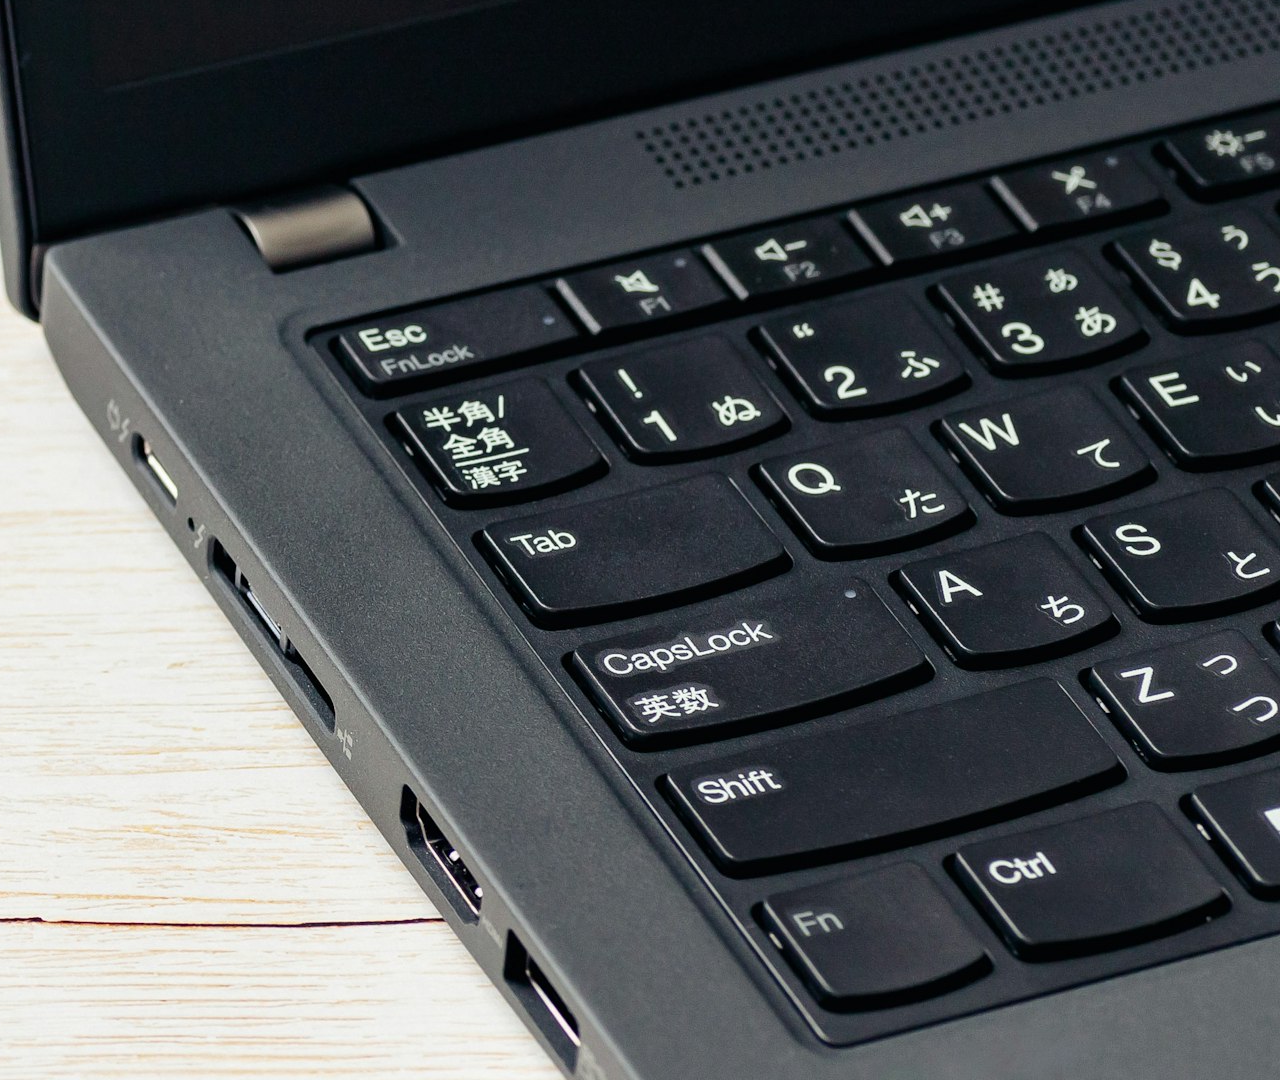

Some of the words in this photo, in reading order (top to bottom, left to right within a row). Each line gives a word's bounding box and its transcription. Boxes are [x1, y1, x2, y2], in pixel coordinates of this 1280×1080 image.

[1076, 193, 1112, 213] F4
[929, 229, 964, 248] F3
[783, 260, 819, 281] F2
[1149, 239, 1182, 271] $
[639, 295, 671, 315] F1
[973, 283, 1005, 312] #
[1186, 278, 1220, 309] 4
[1075, 306, 1117, 337] あ
[358, 325, 427, 352] Esc
[1001, 322, 1045, 355] 3
[380, 344, 474, 377] FnLock
[900, 350, 940, 379] ふ
[618, 368, 643, 399] !
[823, 365, 868, 400] 2
[1148, 372, 1200, 407] E
[424, 394, 507, 432] 半角/
[643, 410, 678, 442] 1
[712, 395, 762, 426] ぬ
[442, 426, 515, 460] 全角
[958, 413, 1020, 453] W
[1076, 438, 1120, 468] て
[463, 461, 527, 490] 漢字
[787, 462, 842, 495] Q
[899, 489, 946, 519] た
[509, 529, 577, 556] Tab
[1115, 524, 1161, 556] S
[1227, 551, 1271, 579] と
[938, 569, 983, 603] A
[1040, 595, 1085, 624] ち
[603, 622, 774, 675] CapsLock
[1121, 666, 1175, 707] Z
[639, 686, 718, 723] 英数
[1232, 695, 1279, 722] つ
[697, 770, 782, 804] Shift
[988, 851, 1057, 884] Ctrl
[793, 910, 844, 939] Fn
